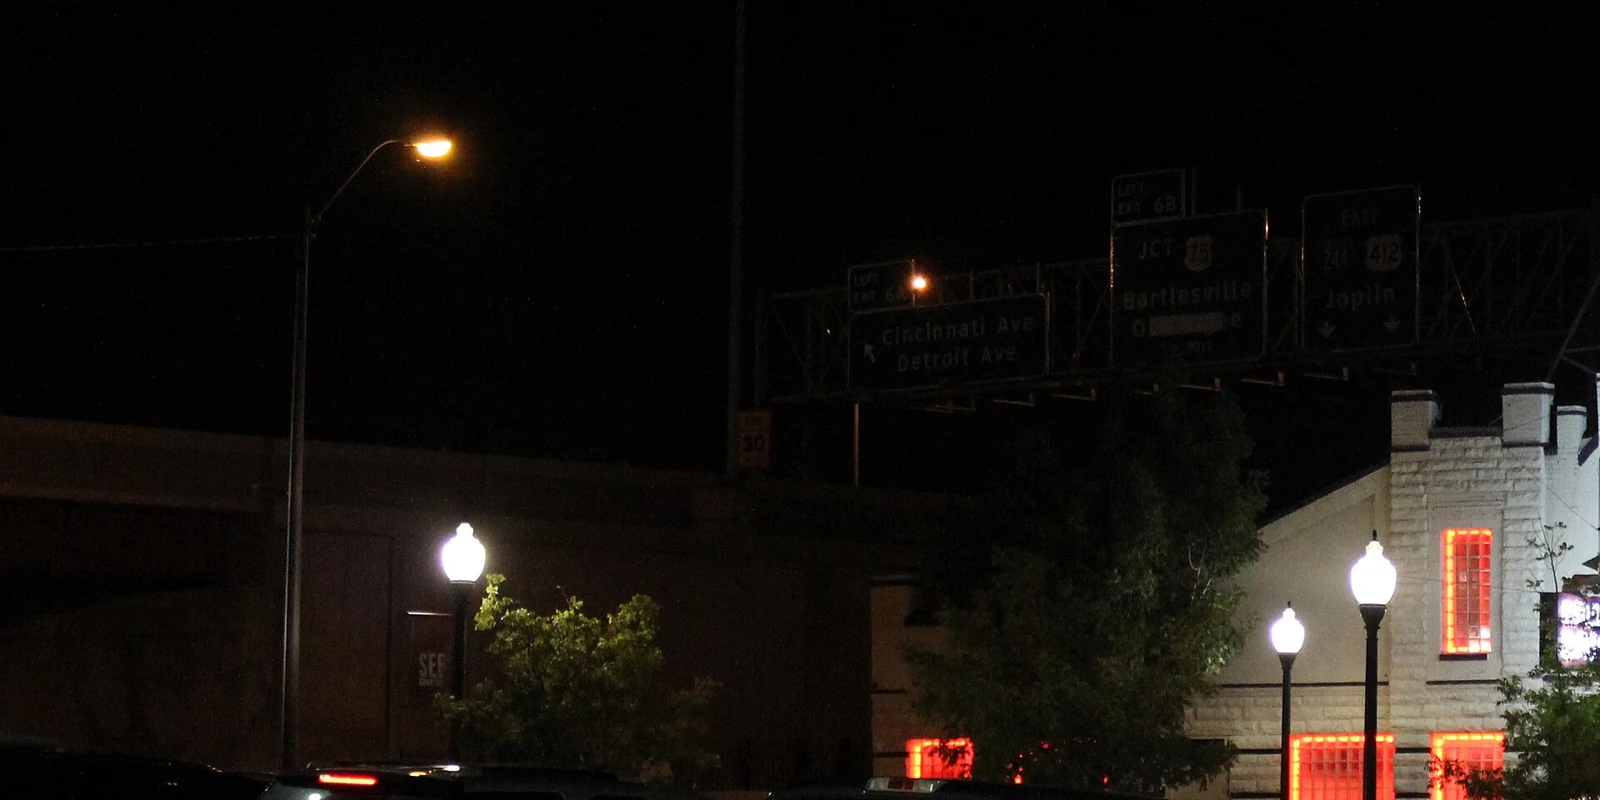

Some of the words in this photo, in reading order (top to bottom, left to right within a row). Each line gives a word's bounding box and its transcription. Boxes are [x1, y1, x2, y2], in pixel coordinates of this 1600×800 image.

[1138, 238, 1175, 260] JCT
[1369, 241, 1399, 264] 412
[1123, 278, 1251, 312] Bartlesville
[1324, 283, 1396, 312] Joplin
[881, 315, 986, 346] Cincinnati
[997, 314, 1035, 335] Ave
[896, 346, 969, 373] Detroit
[980, 344, 1017, 365] Ave
[743, 435, 765, 452] 30
